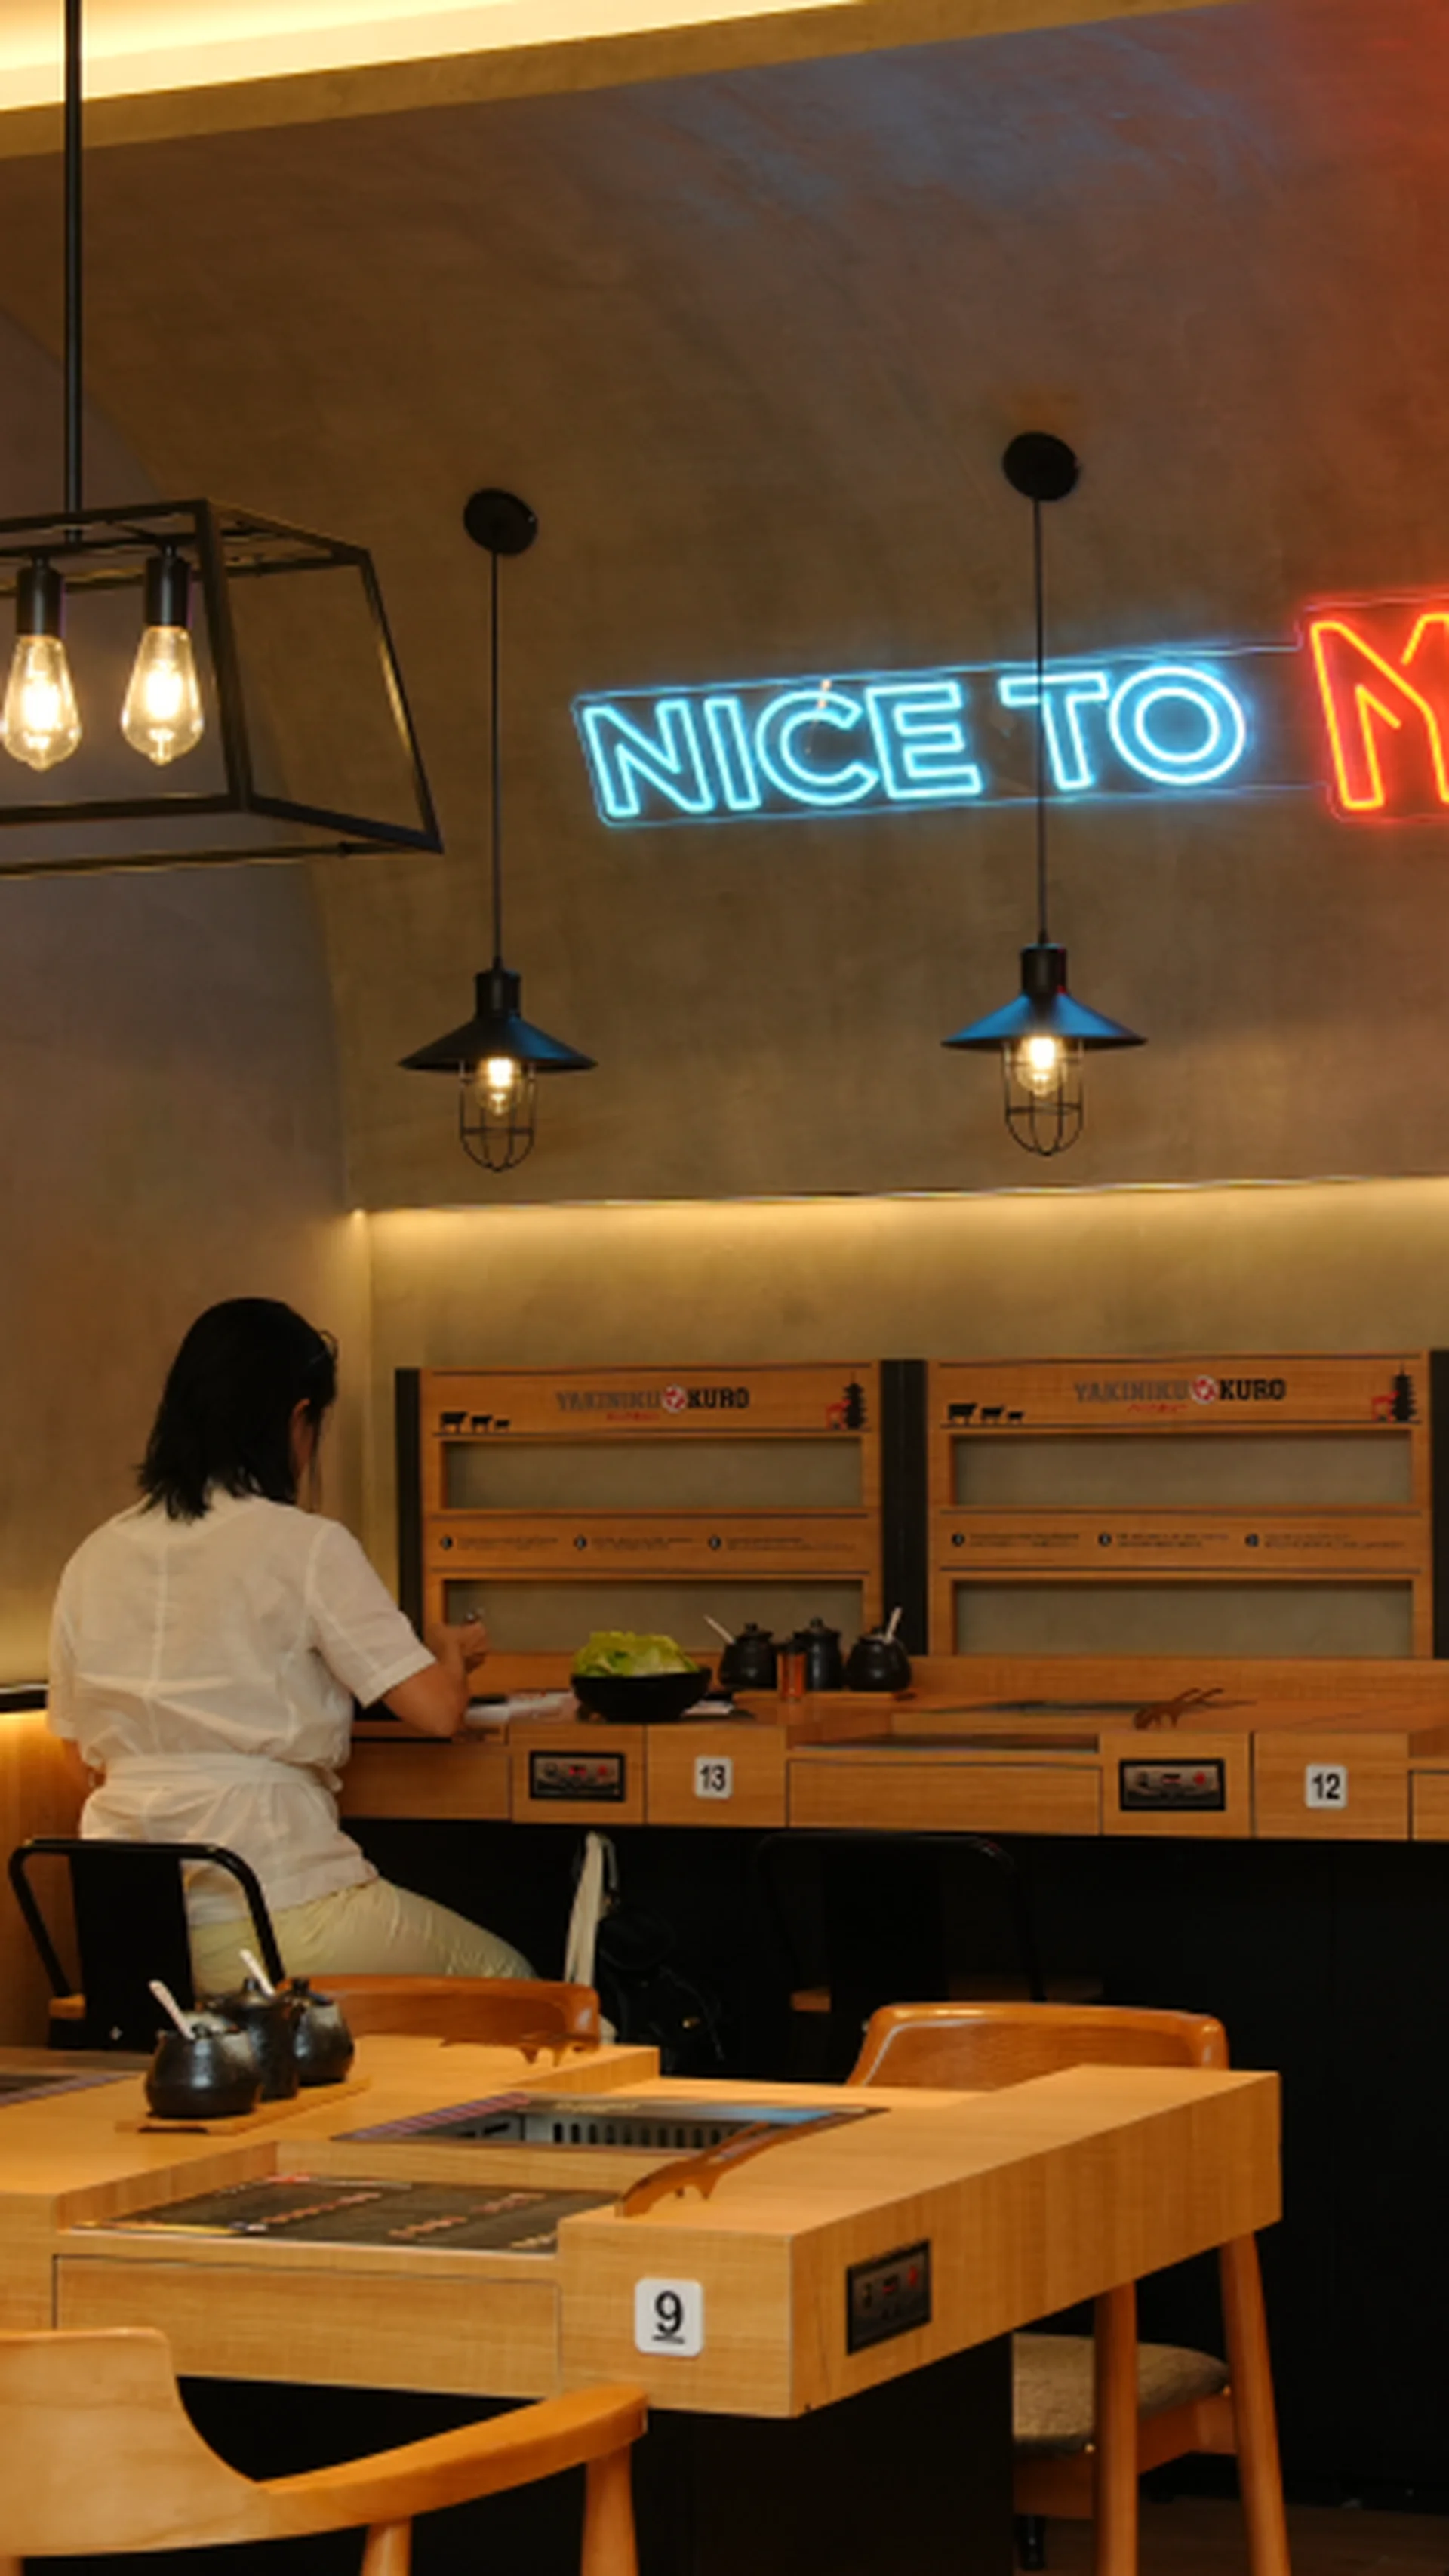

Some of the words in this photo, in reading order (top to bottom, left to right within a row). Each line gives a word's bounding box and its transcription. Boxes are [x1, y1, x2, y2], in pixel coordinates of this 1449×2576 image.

[583, 679, 981, 817] NICE
[998, 664, 1247, 791] TO
[555, 1391, 661, 1411] YAKINIKU
[688, 1387, 750, 1409] KURO
[1075, 1380, 1190, 1402] YAKINIKU
[1219, 1379, 1286, 1401] KURO
[700, 1764, 726, 1792] 13
[1312, 1773, 1340, 1801] 12
[654, 2290, 684, 2337] 9
